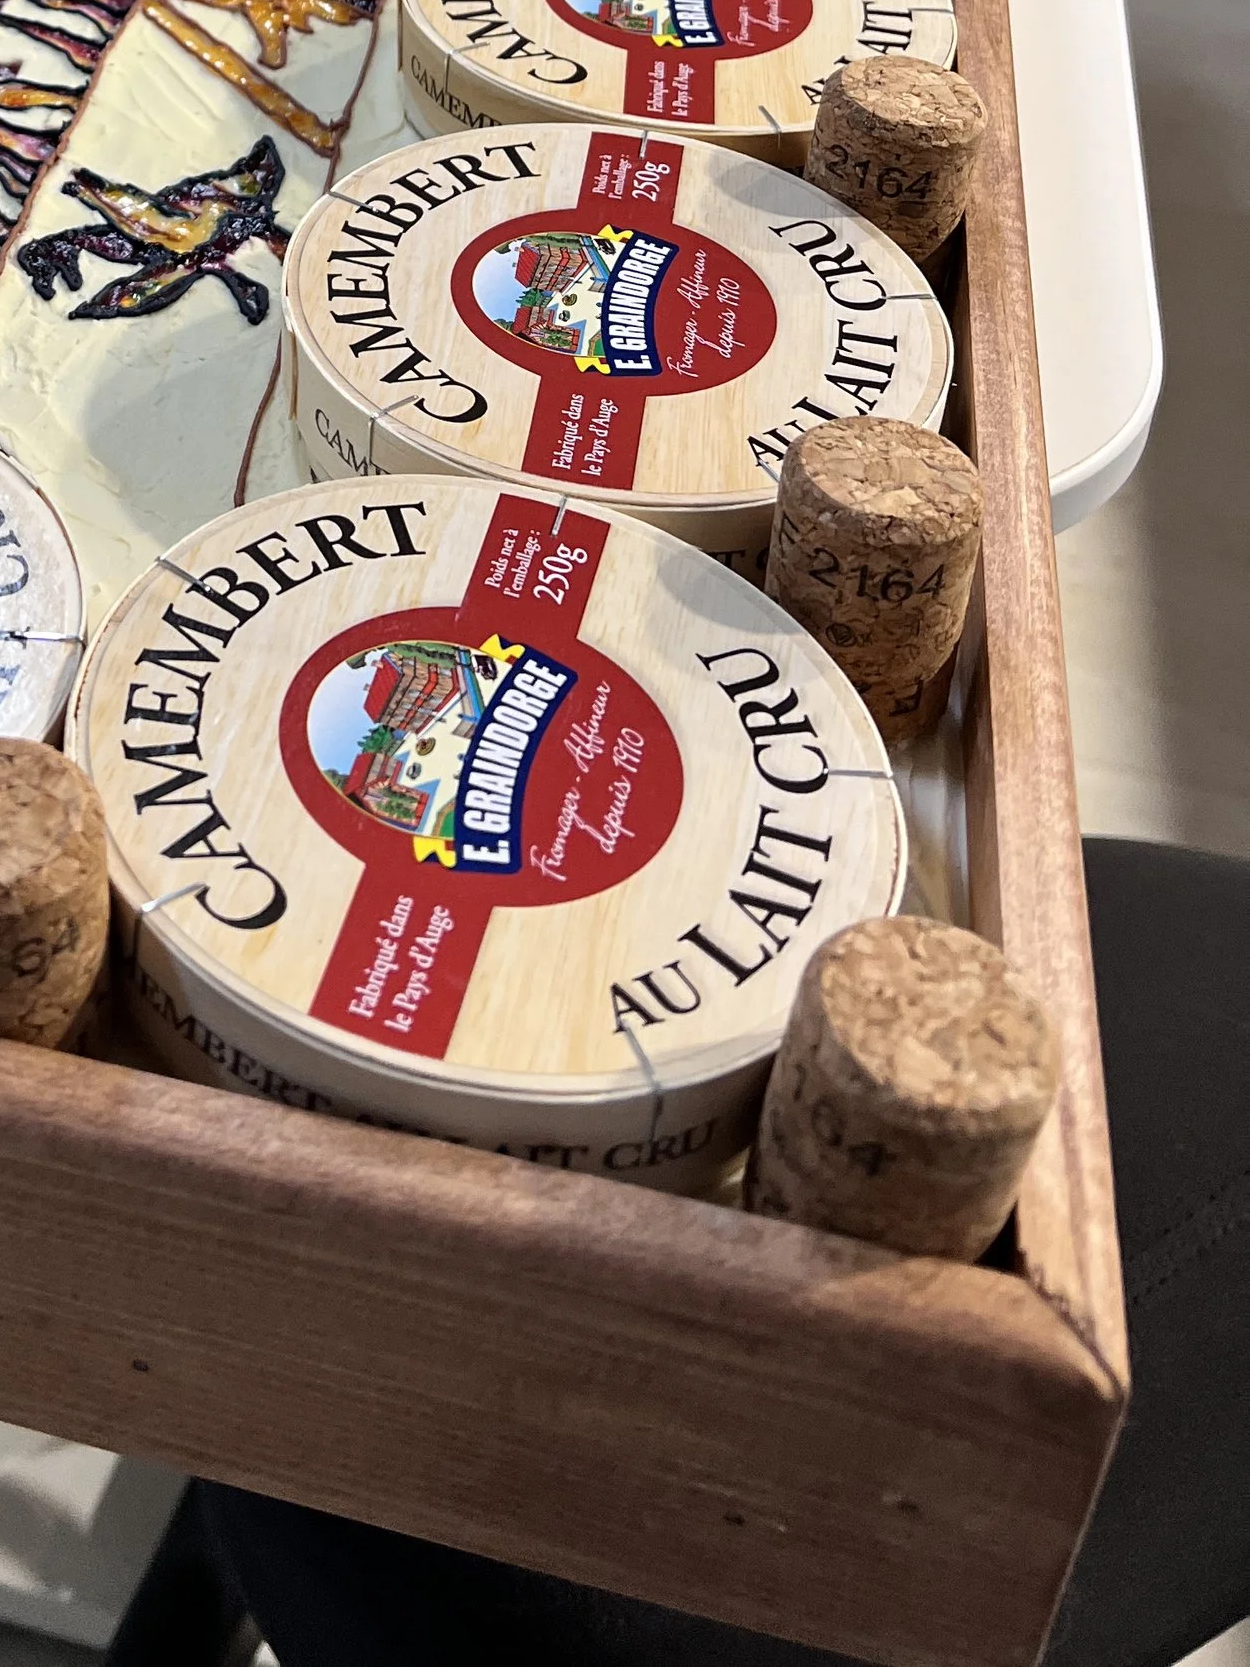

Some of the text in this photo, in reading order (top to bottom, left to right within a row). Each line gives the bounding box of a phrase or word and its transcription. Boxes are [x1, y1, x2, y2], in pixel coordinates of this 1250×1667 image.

[856, 0, 915, 55] AIT
[631, 160, 671, 203] 250g
[825, 143, 934, 202] 2164
[326, 140, 542, 425] CAMEMBERT
[608, 238, 673, 371] E. GRAINDORGE
[676, 248, 708, 309] Affineur
[768, 219, 888, 313] CRU
[712, 276, 747, 360] depuis 1910
[551, 392, 585, 472] Fabriqué dans
[580, 460, 602, 478] le
[586, 434, 611, 464] Pays
[484, 560, 508, 591] Poids
[498, 538, 517, 562] net
[503, 535, 541, 600] l'emballage
[533, 542, 588, 605] 250g
[809, 546, 945, 604] 2164
[120, 500, 427, 930] CAMEMBERT
[695, 646, 829, 795] CRU
[462, 658, 568, 865] E. GRAINDORGE
[529, 679, 612, 883] Fromager Affineur
[596, 727, 645, 855] depuis 1910
[676, 803, 834, 988] LAIT
[348, 893, 414, 1019] Fabriqué dans
[383, 904, 455, 1034] le Pays d'Auge
[609, 959, 703, 1033] AU
[603, 1117, 719, 1173] CRU
